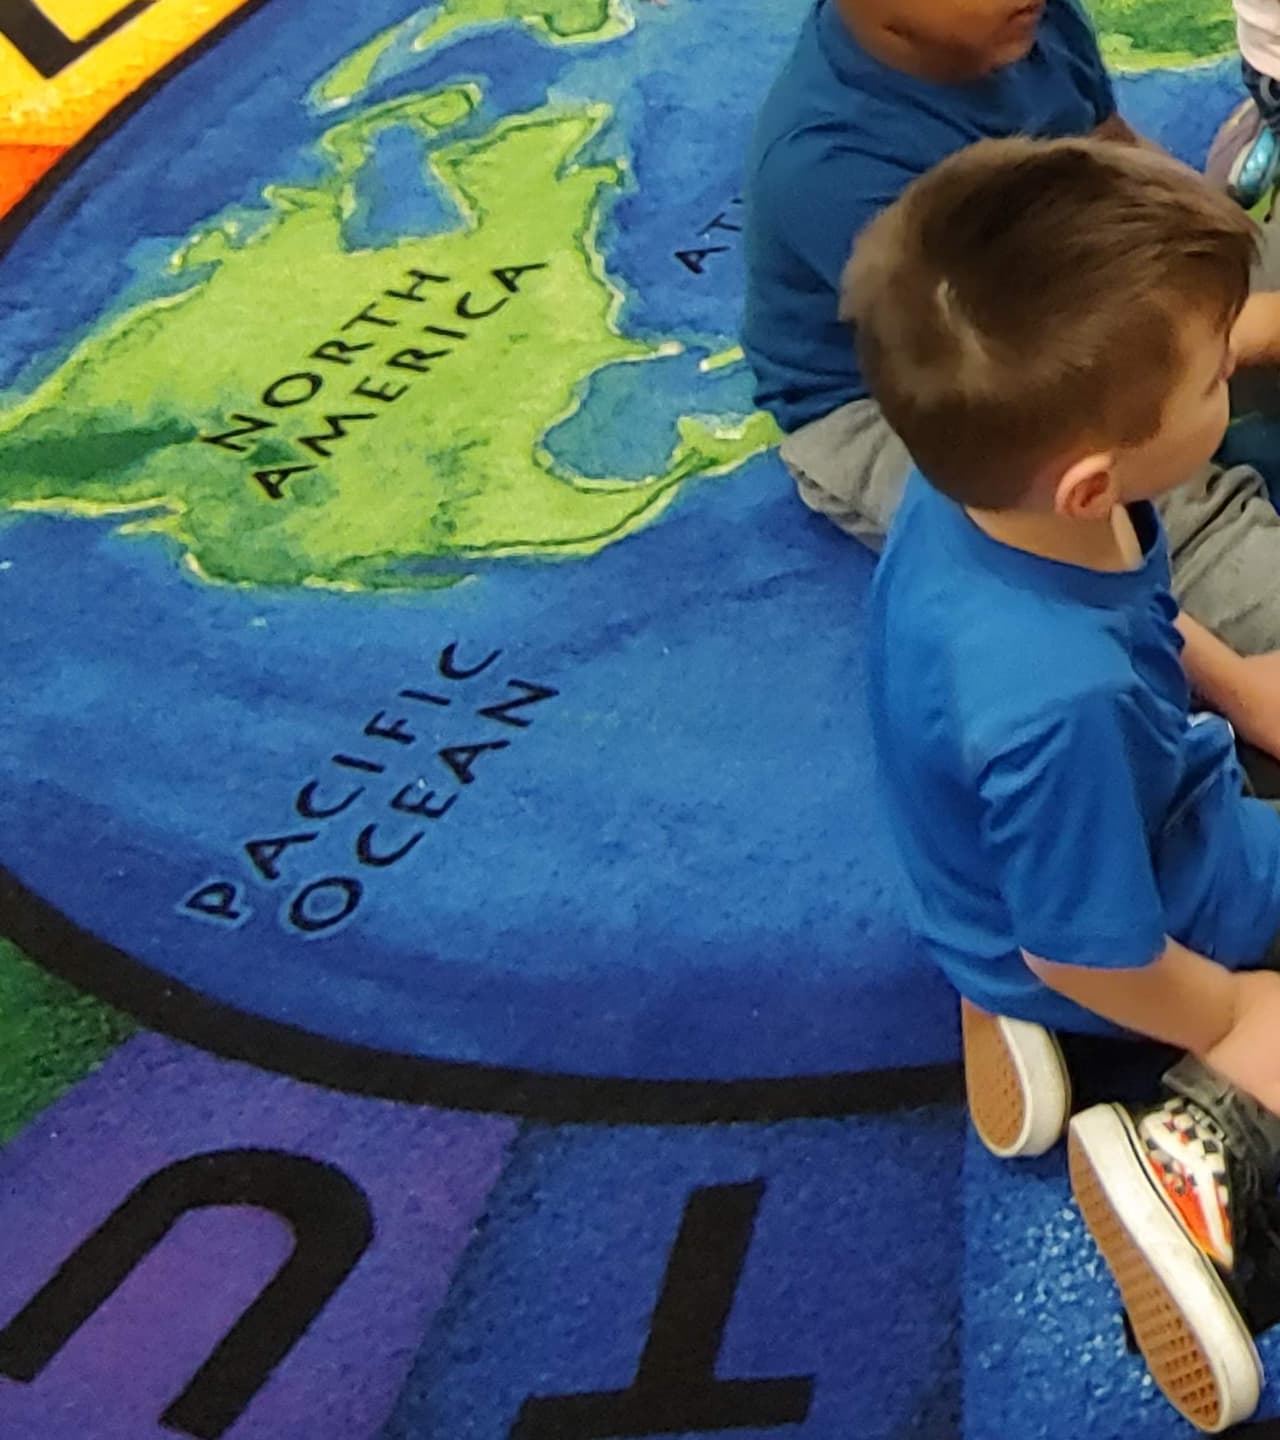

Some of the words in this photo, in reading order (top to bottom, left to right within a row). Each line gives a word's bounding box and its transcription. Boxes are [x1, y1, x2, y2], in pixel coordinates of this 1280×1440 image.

[202, 267, 450, 455] NORTH
[251, 260, 549, 500] AMERICA
[185, 641, 503, 921] PACIFIC
[288, 678, 561, 932] OCEAN
[0, 1148, 374, 1440] U
[508, 1177, 816, 1440] T
